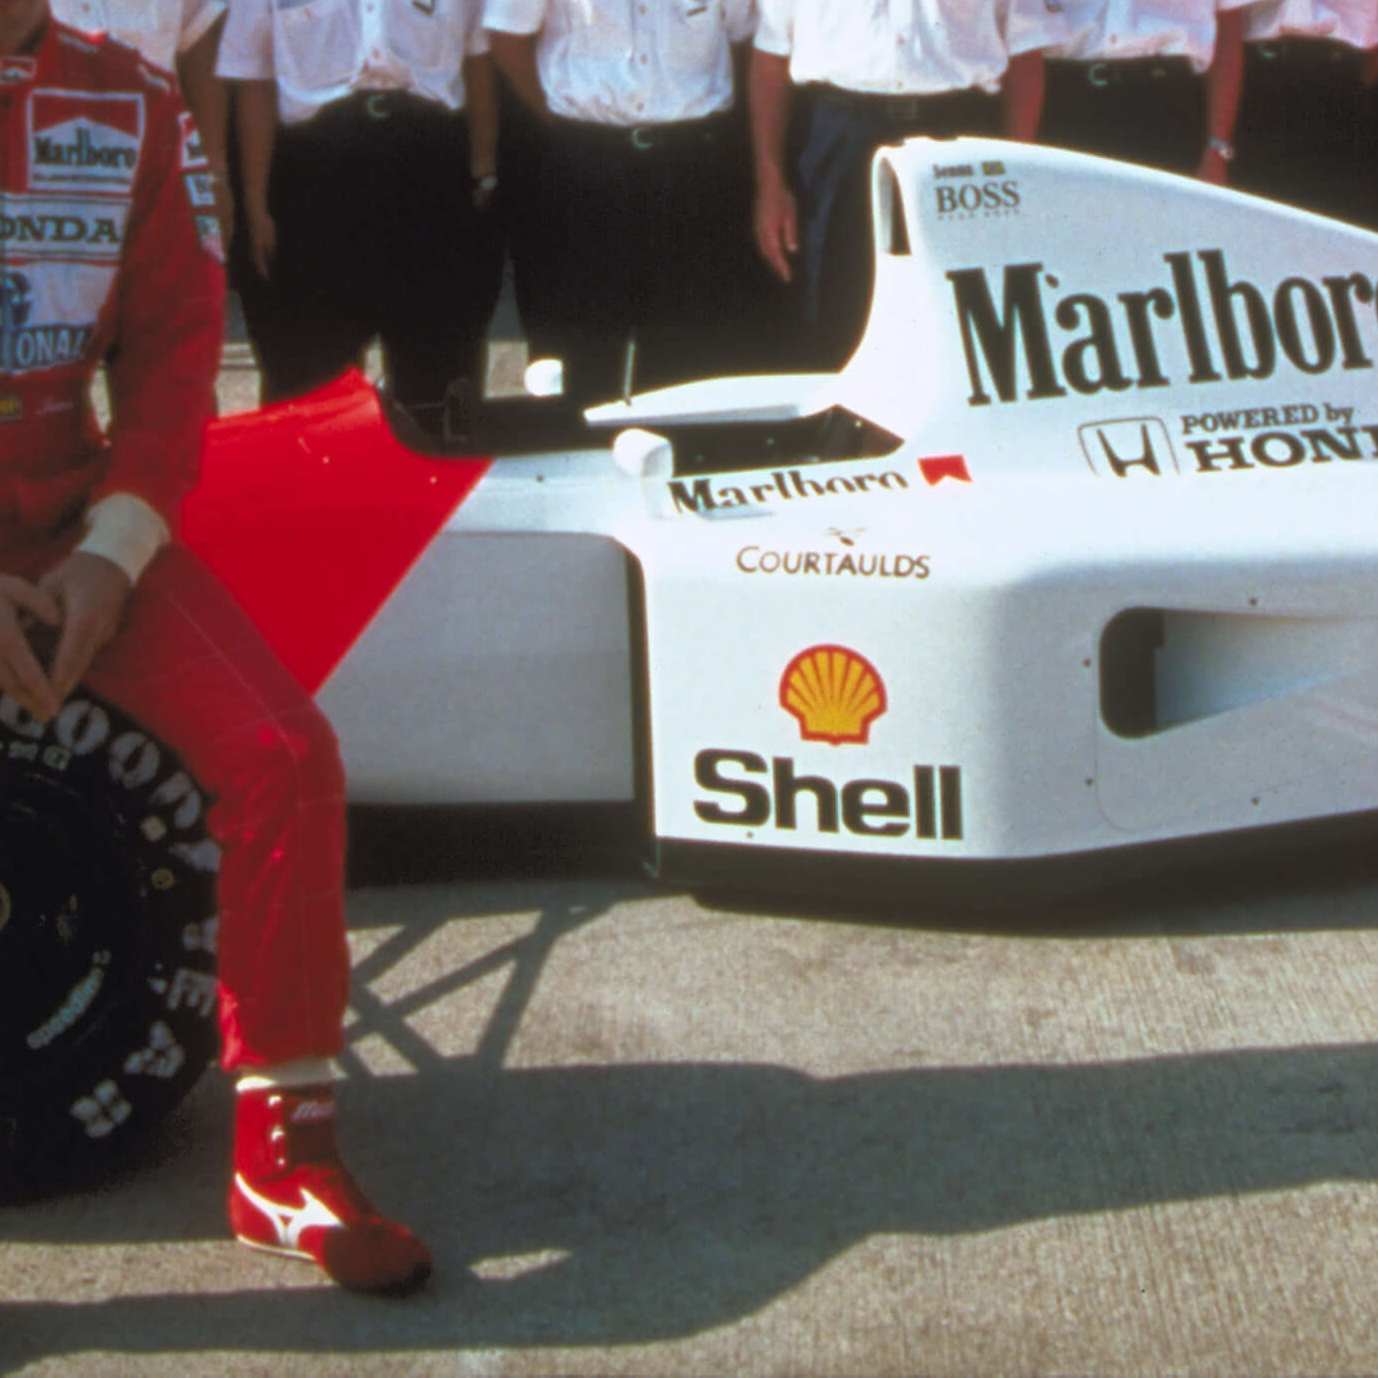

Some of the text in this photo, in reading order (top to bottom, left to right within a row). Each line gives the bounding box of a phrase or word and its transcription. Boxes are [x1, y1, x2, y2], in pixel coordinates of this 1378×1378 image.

[34, 126, 137, 168] Marlboro
[935, 179, 1021, 215] BOSS
[1180, 402, 1356, 436] POWERED by
[736, 545, 932, 580] COURTAULDS
[693, 747, 965, 841] Shell
